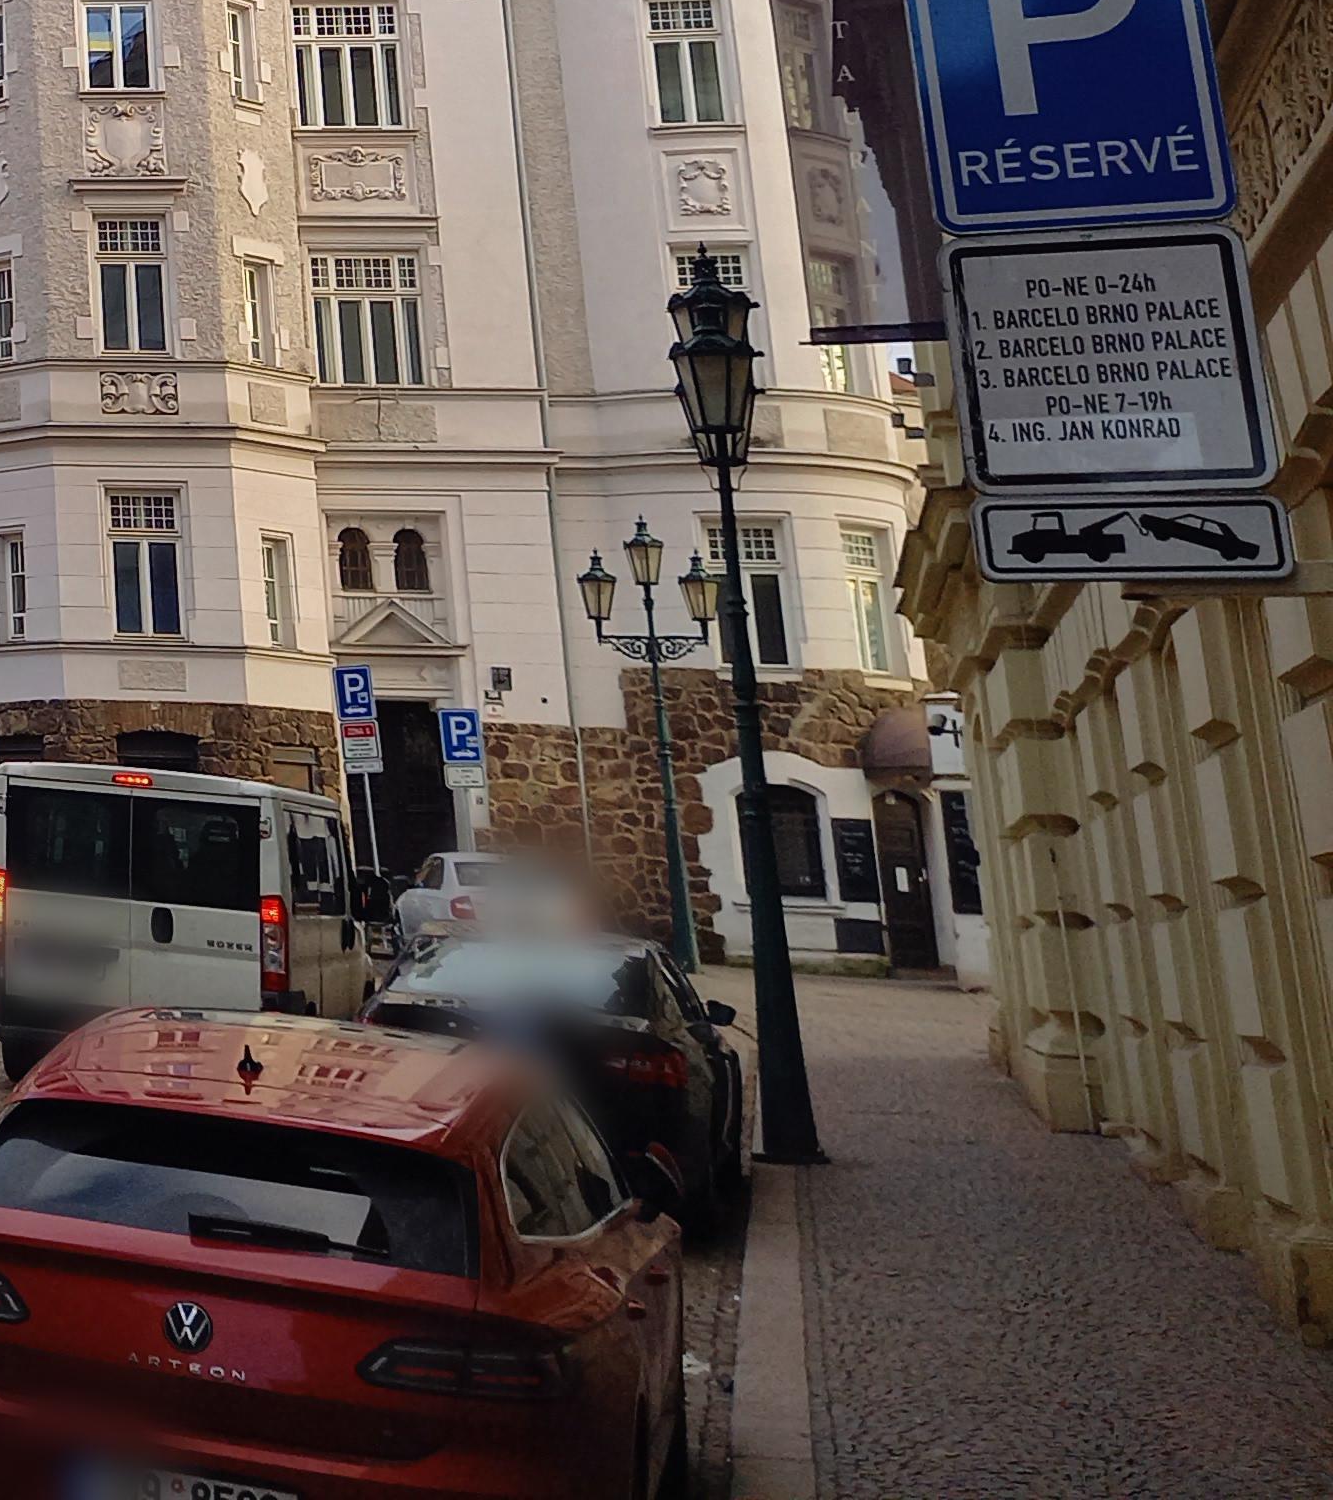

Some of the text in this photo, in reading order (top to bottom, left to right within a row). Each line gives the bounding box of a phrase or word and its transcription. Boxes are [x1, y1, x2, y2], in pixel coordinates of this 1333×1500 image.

[958, 124, 1200, 187] RÉSERVÉ
[1026, 273, 1157, 299] PO-NE 0-24h
[972, 298, 1221, 331] 1. BARCELO BRNO PALACE
[975, 328, 1227, 360] 2. BARCELO BRNO PALACE
[978, 357, 1233, 389] 3. BARCELO BRNO PALACE
[1046, 390, 1173, 416] PO-NE 7-19h
[988, 417, 1181, 443] 4. ING. JAN KONRAD
[128, 1352, 246, 1382] ARTEON
